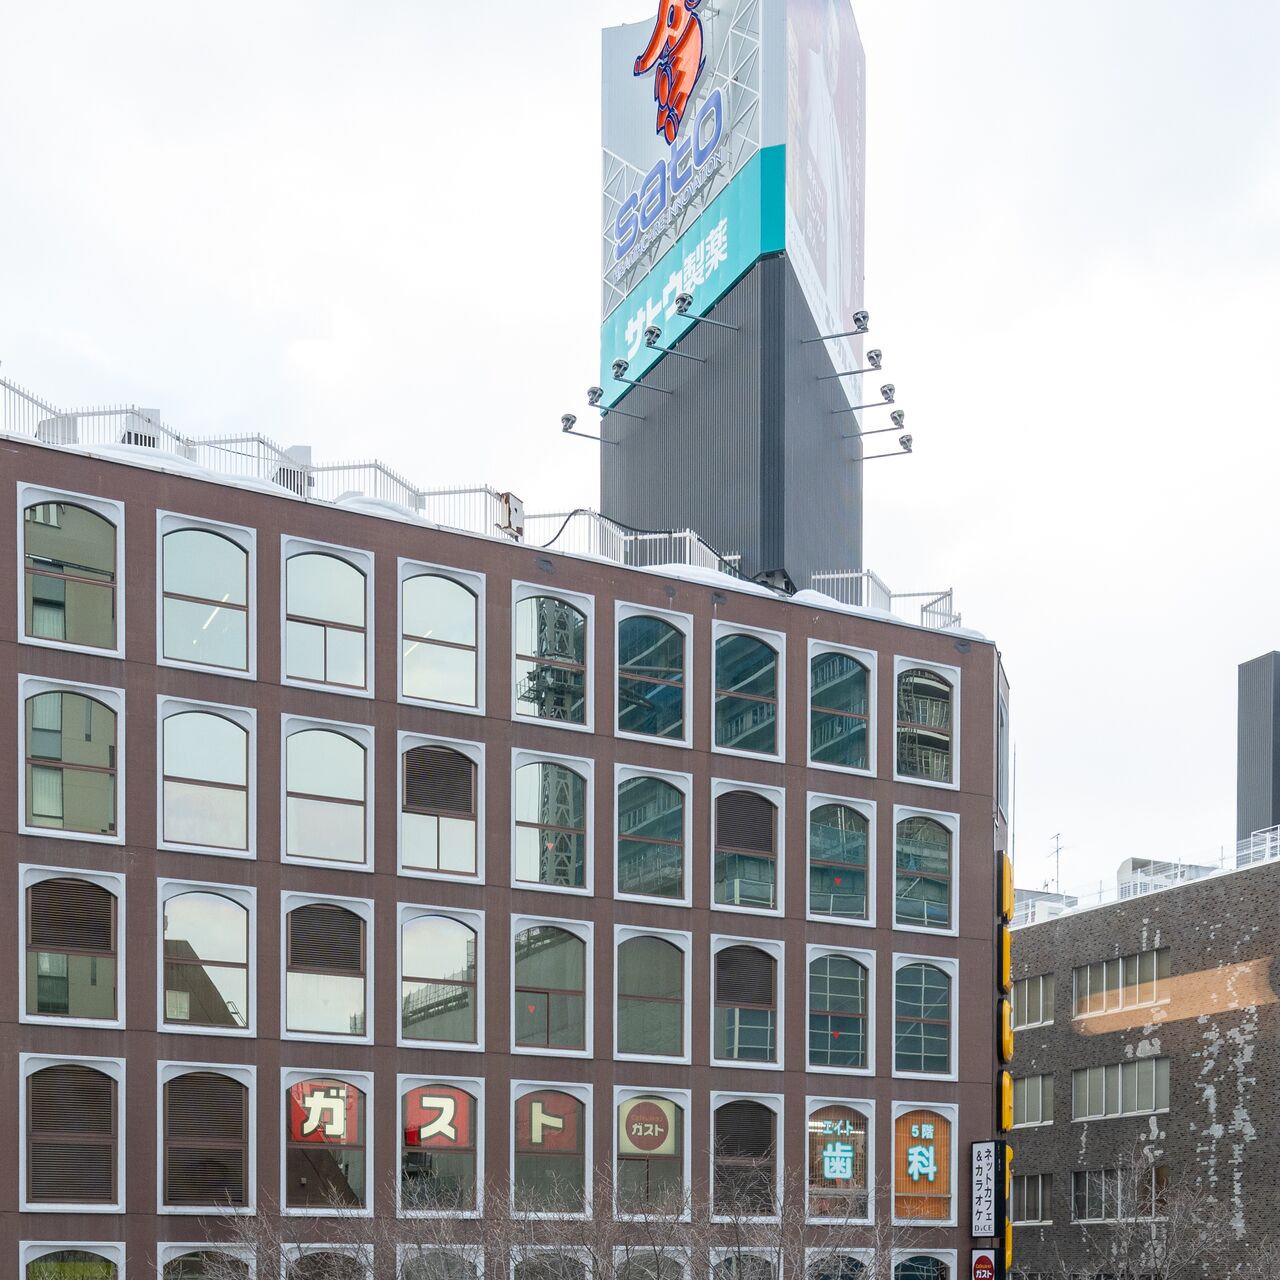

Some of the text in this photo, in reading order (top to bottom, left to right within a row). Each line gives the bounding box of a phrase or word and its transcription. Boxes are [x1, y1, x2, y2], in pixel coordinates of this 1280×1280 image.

[624, 217, 728, 359] サトウ製薬
[632, 1124, 664, 1138] ガスト
[823, 1119, 853, 1135] エイト
[984, 1149, 992, 1221] ネットカフェ
[976, 1269, 992, 1279] ガスト
